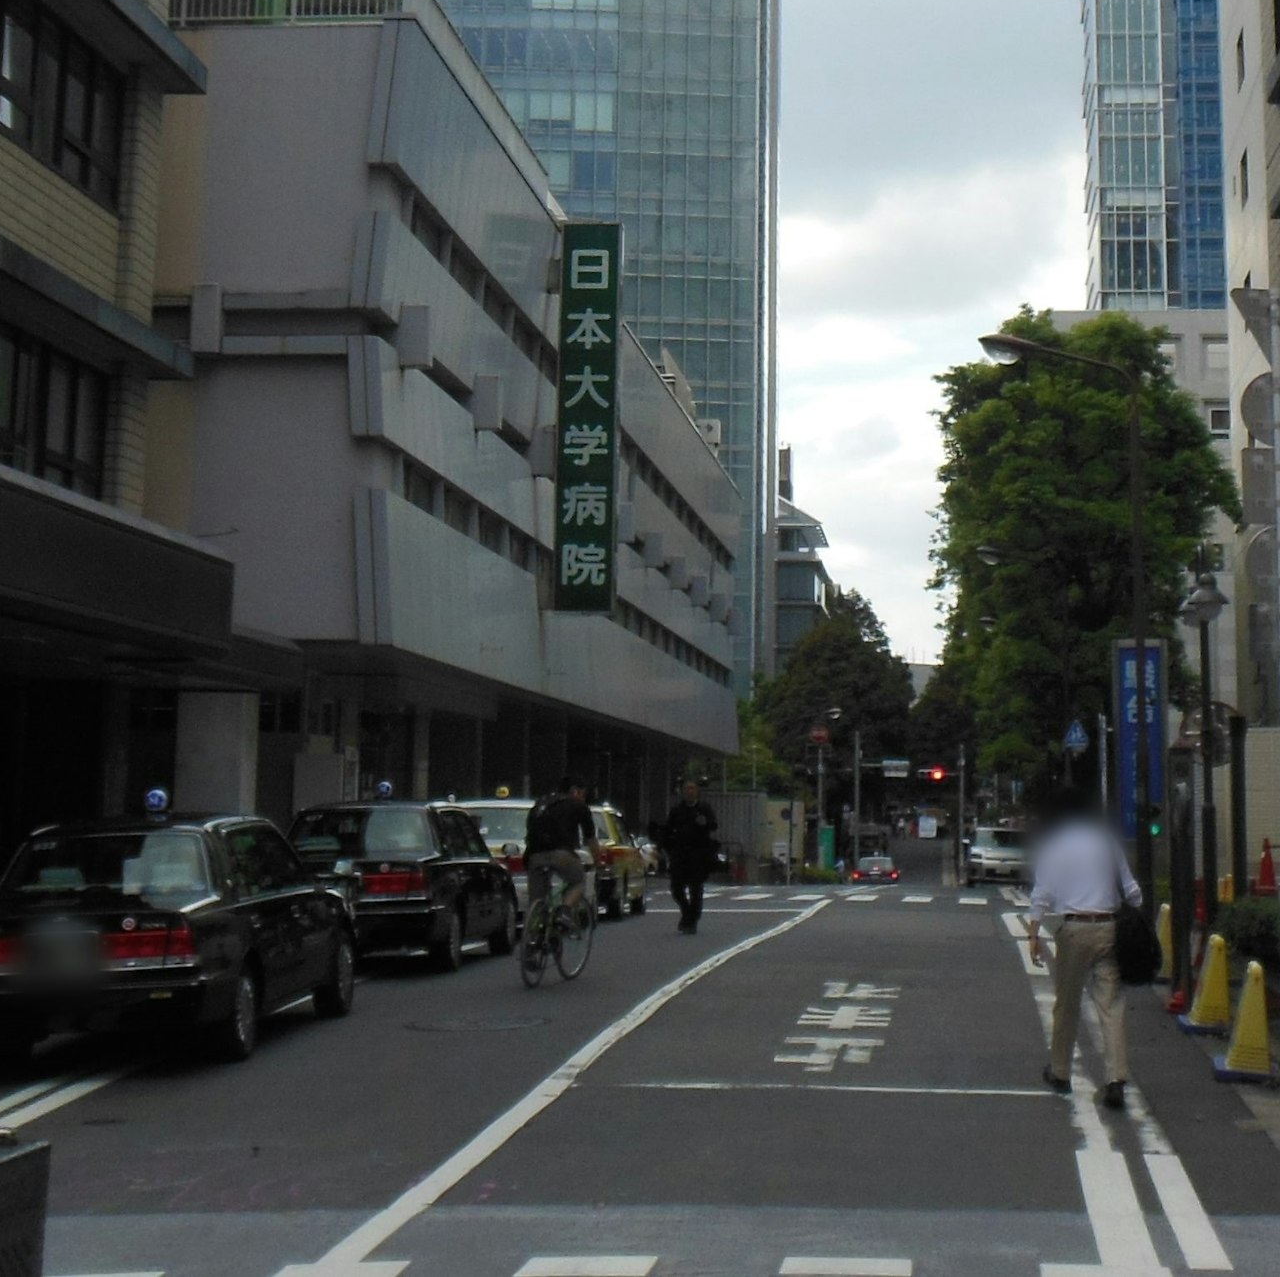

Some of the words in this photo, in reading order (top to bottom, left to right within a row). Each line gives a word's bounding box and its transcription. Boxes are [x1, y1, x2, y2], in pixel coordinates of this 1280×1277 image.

[561, 249, 611, 587] 日本大学病院
